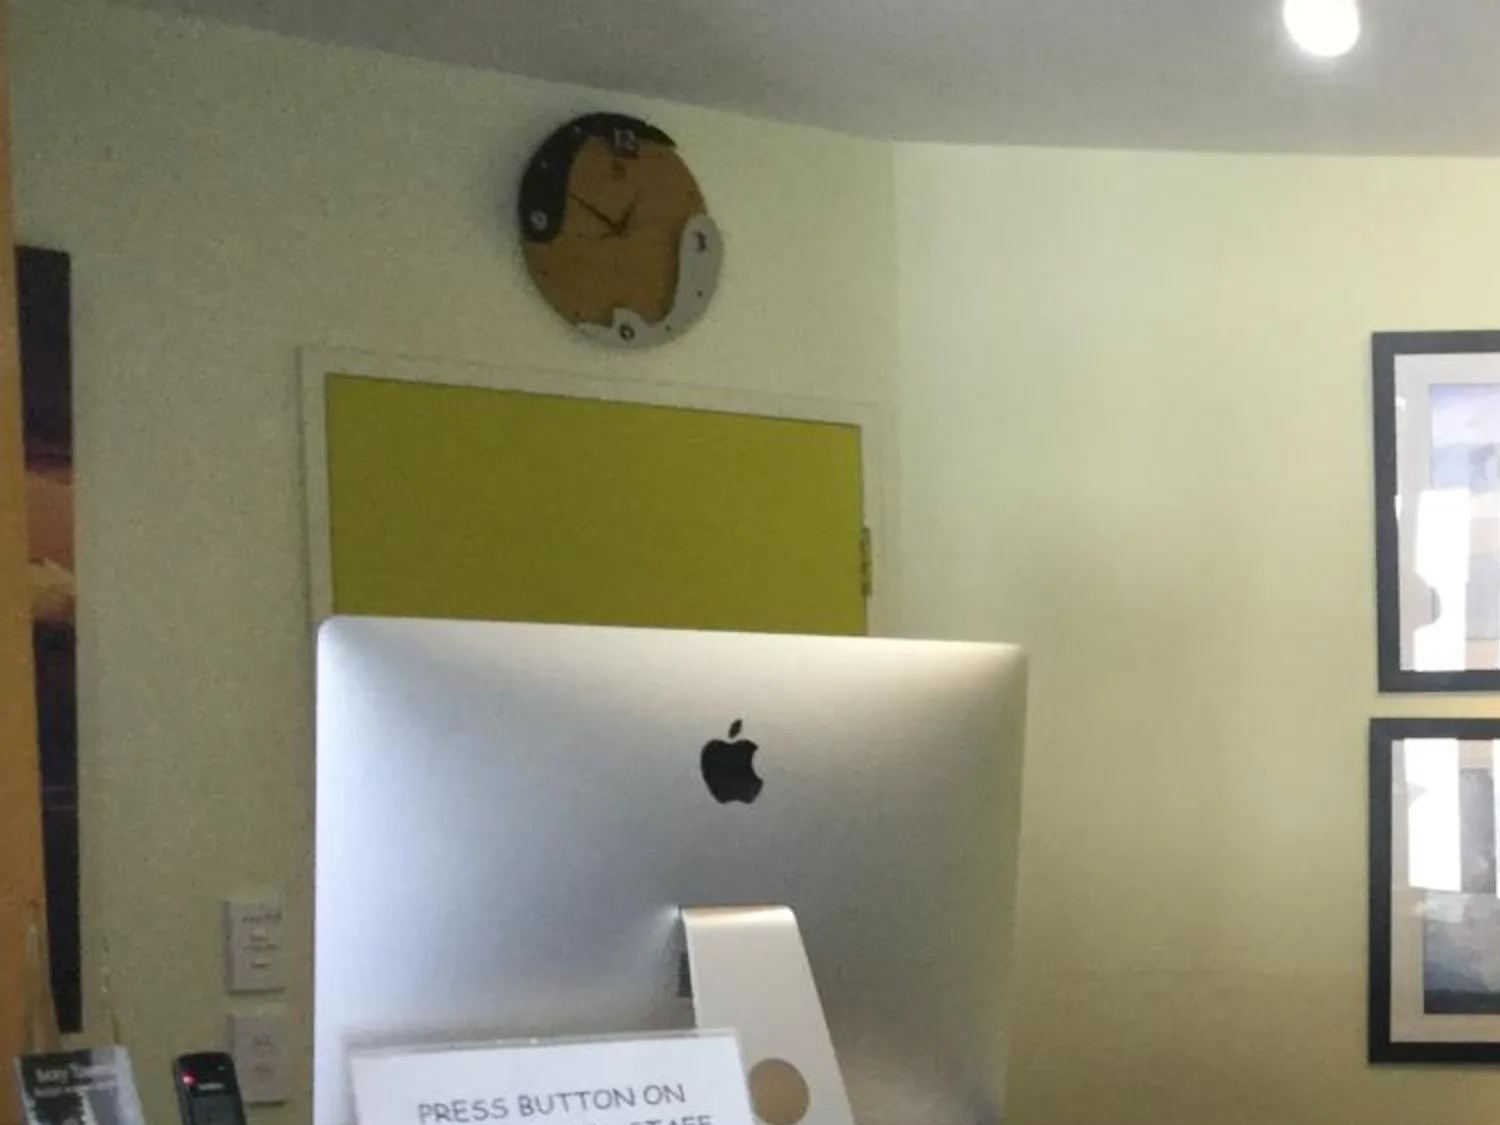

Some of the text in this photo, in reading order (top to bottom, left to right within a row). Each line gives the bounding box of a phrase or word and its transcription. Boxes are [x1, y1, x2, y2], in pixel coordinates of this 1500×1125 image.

[417, 1083, 686, 1125] PRESS BUTTON ON
